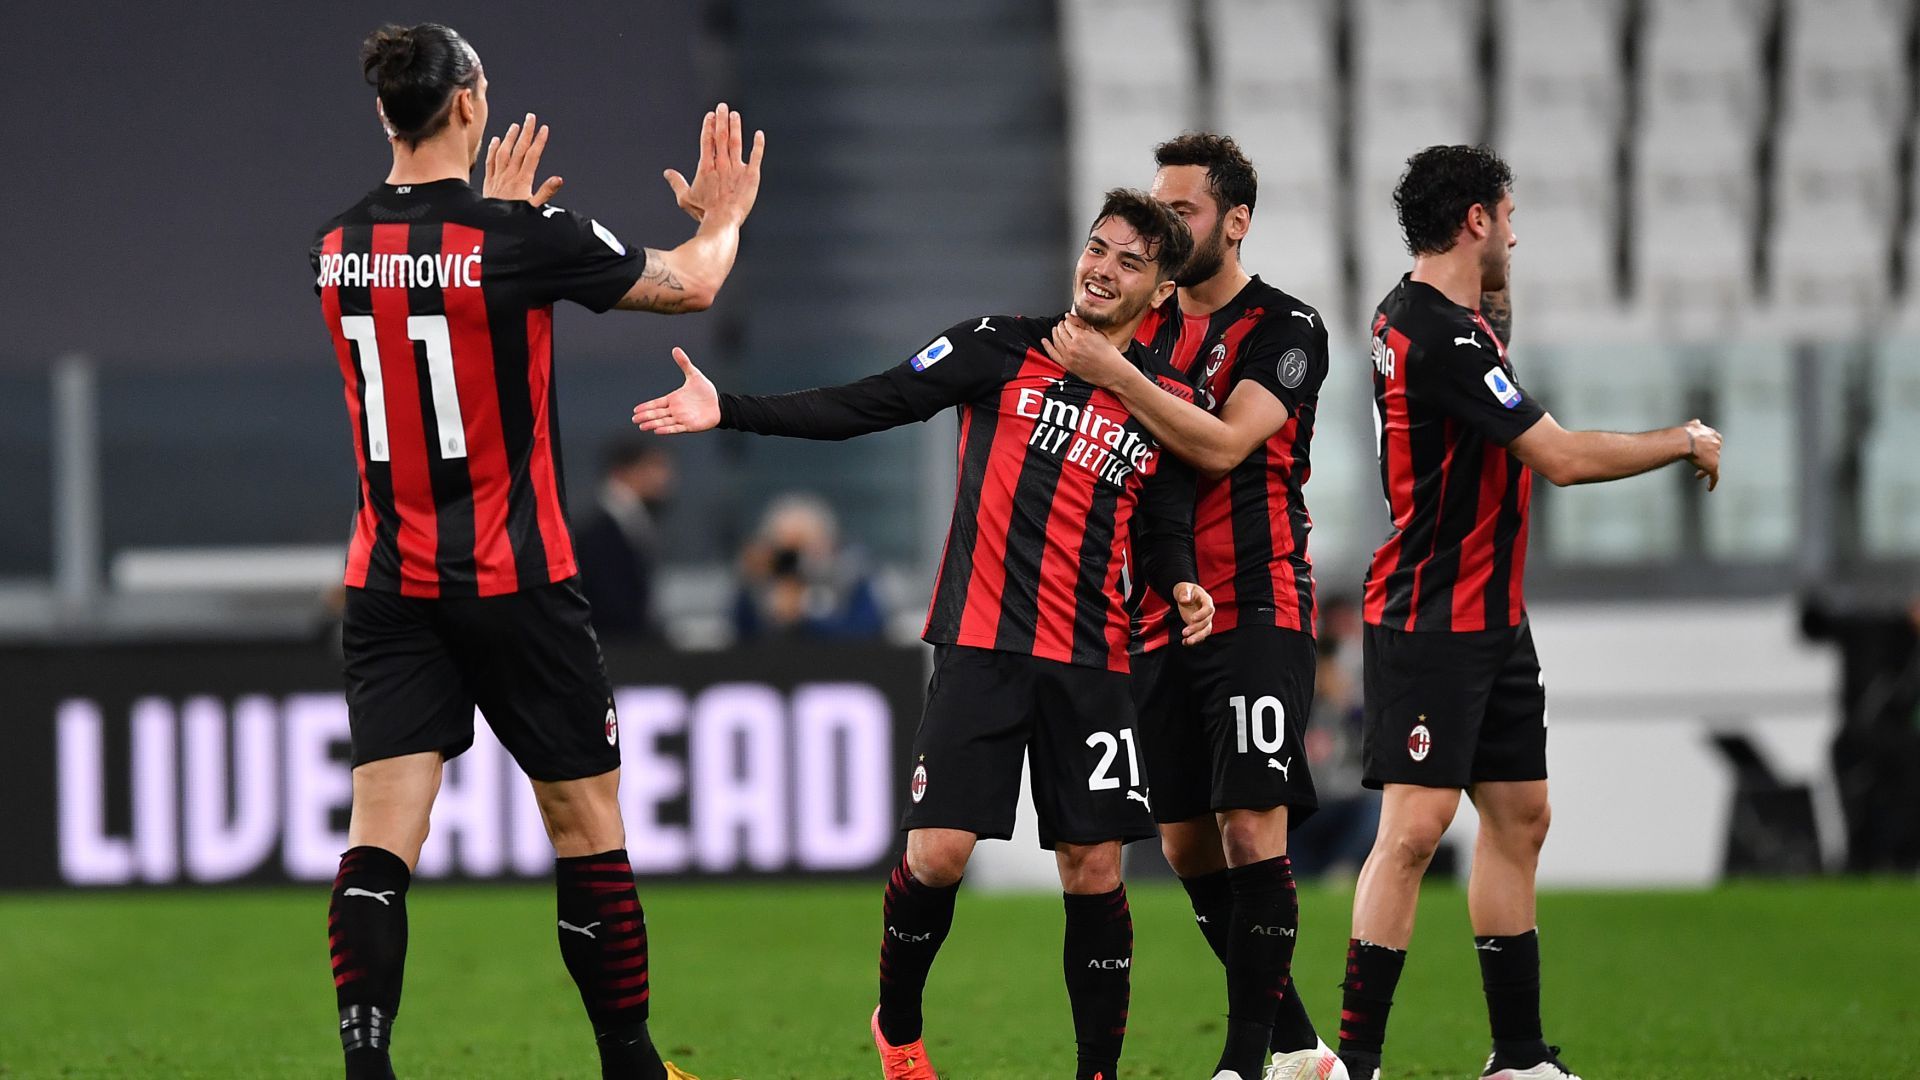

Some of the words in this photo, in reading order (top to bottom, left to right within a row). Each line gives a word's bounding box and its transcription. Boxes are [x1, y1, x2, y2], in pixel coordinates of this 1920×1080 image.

[340, 315, 467, 461] 11
[1016, 387, 1154, 474] Emirates
[1029, 423, 1070, 455] FLY
[1067, 438, 1133, 487] BETTER
[1229, 695, 1285, 754] 10
[57, 694, 353, 884] LIVE
[1085, 728, 1140, 791] 21
[888, 925, 932, 943] ACM
[1250, 924, 1295, 938] ACM
[1088, 957, 1130, 970] ACM
